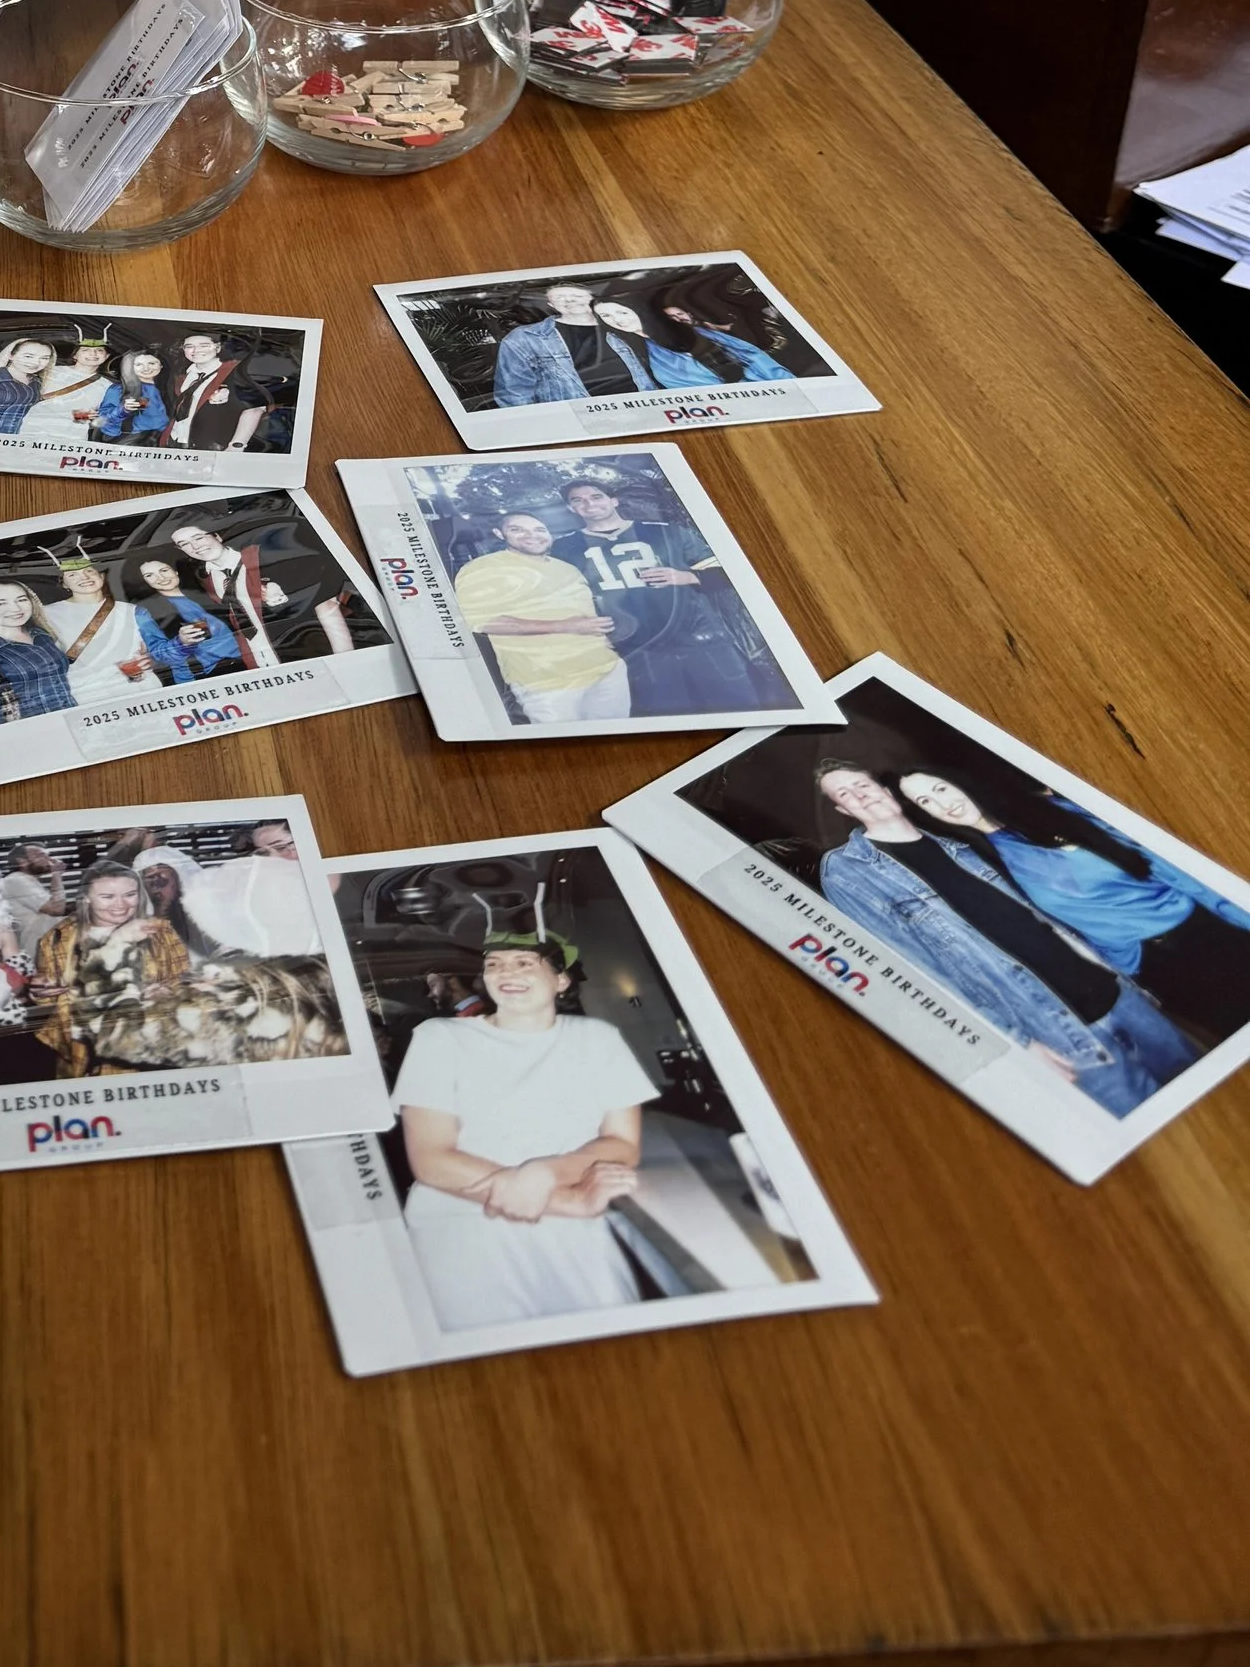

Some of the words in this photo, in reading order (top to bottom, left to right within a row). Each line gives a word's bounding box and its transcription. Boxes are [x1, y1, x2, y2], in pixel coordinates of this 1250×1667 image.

[586, 402, 618, 413] 2025
[622, 394, 702, 409] MILESTONE
[708, 387, 786, 402] BIRTHDAYS
[398, 512, 414, 533] 2025
[406, 534, 438, 590] MILESTONE
[431, 592, 465, 648] BIRTHDAYS
[584, 541, 657, 590] 12
[84, 710, 120, 726] 2025
[126, 689, 220, 718] MILESTONE
[227, 670, 314, 696] BIRTHDAYS
[744, 864, 782, 893] 2025
[784, 894, 880, 968] MILESTONE
[880, 966, 982, 1047] BIRTHDAYS
[104, 1078, 221, 1102] BIRTHDAYS
[348, 1134, 382, 1200] HDAYS
